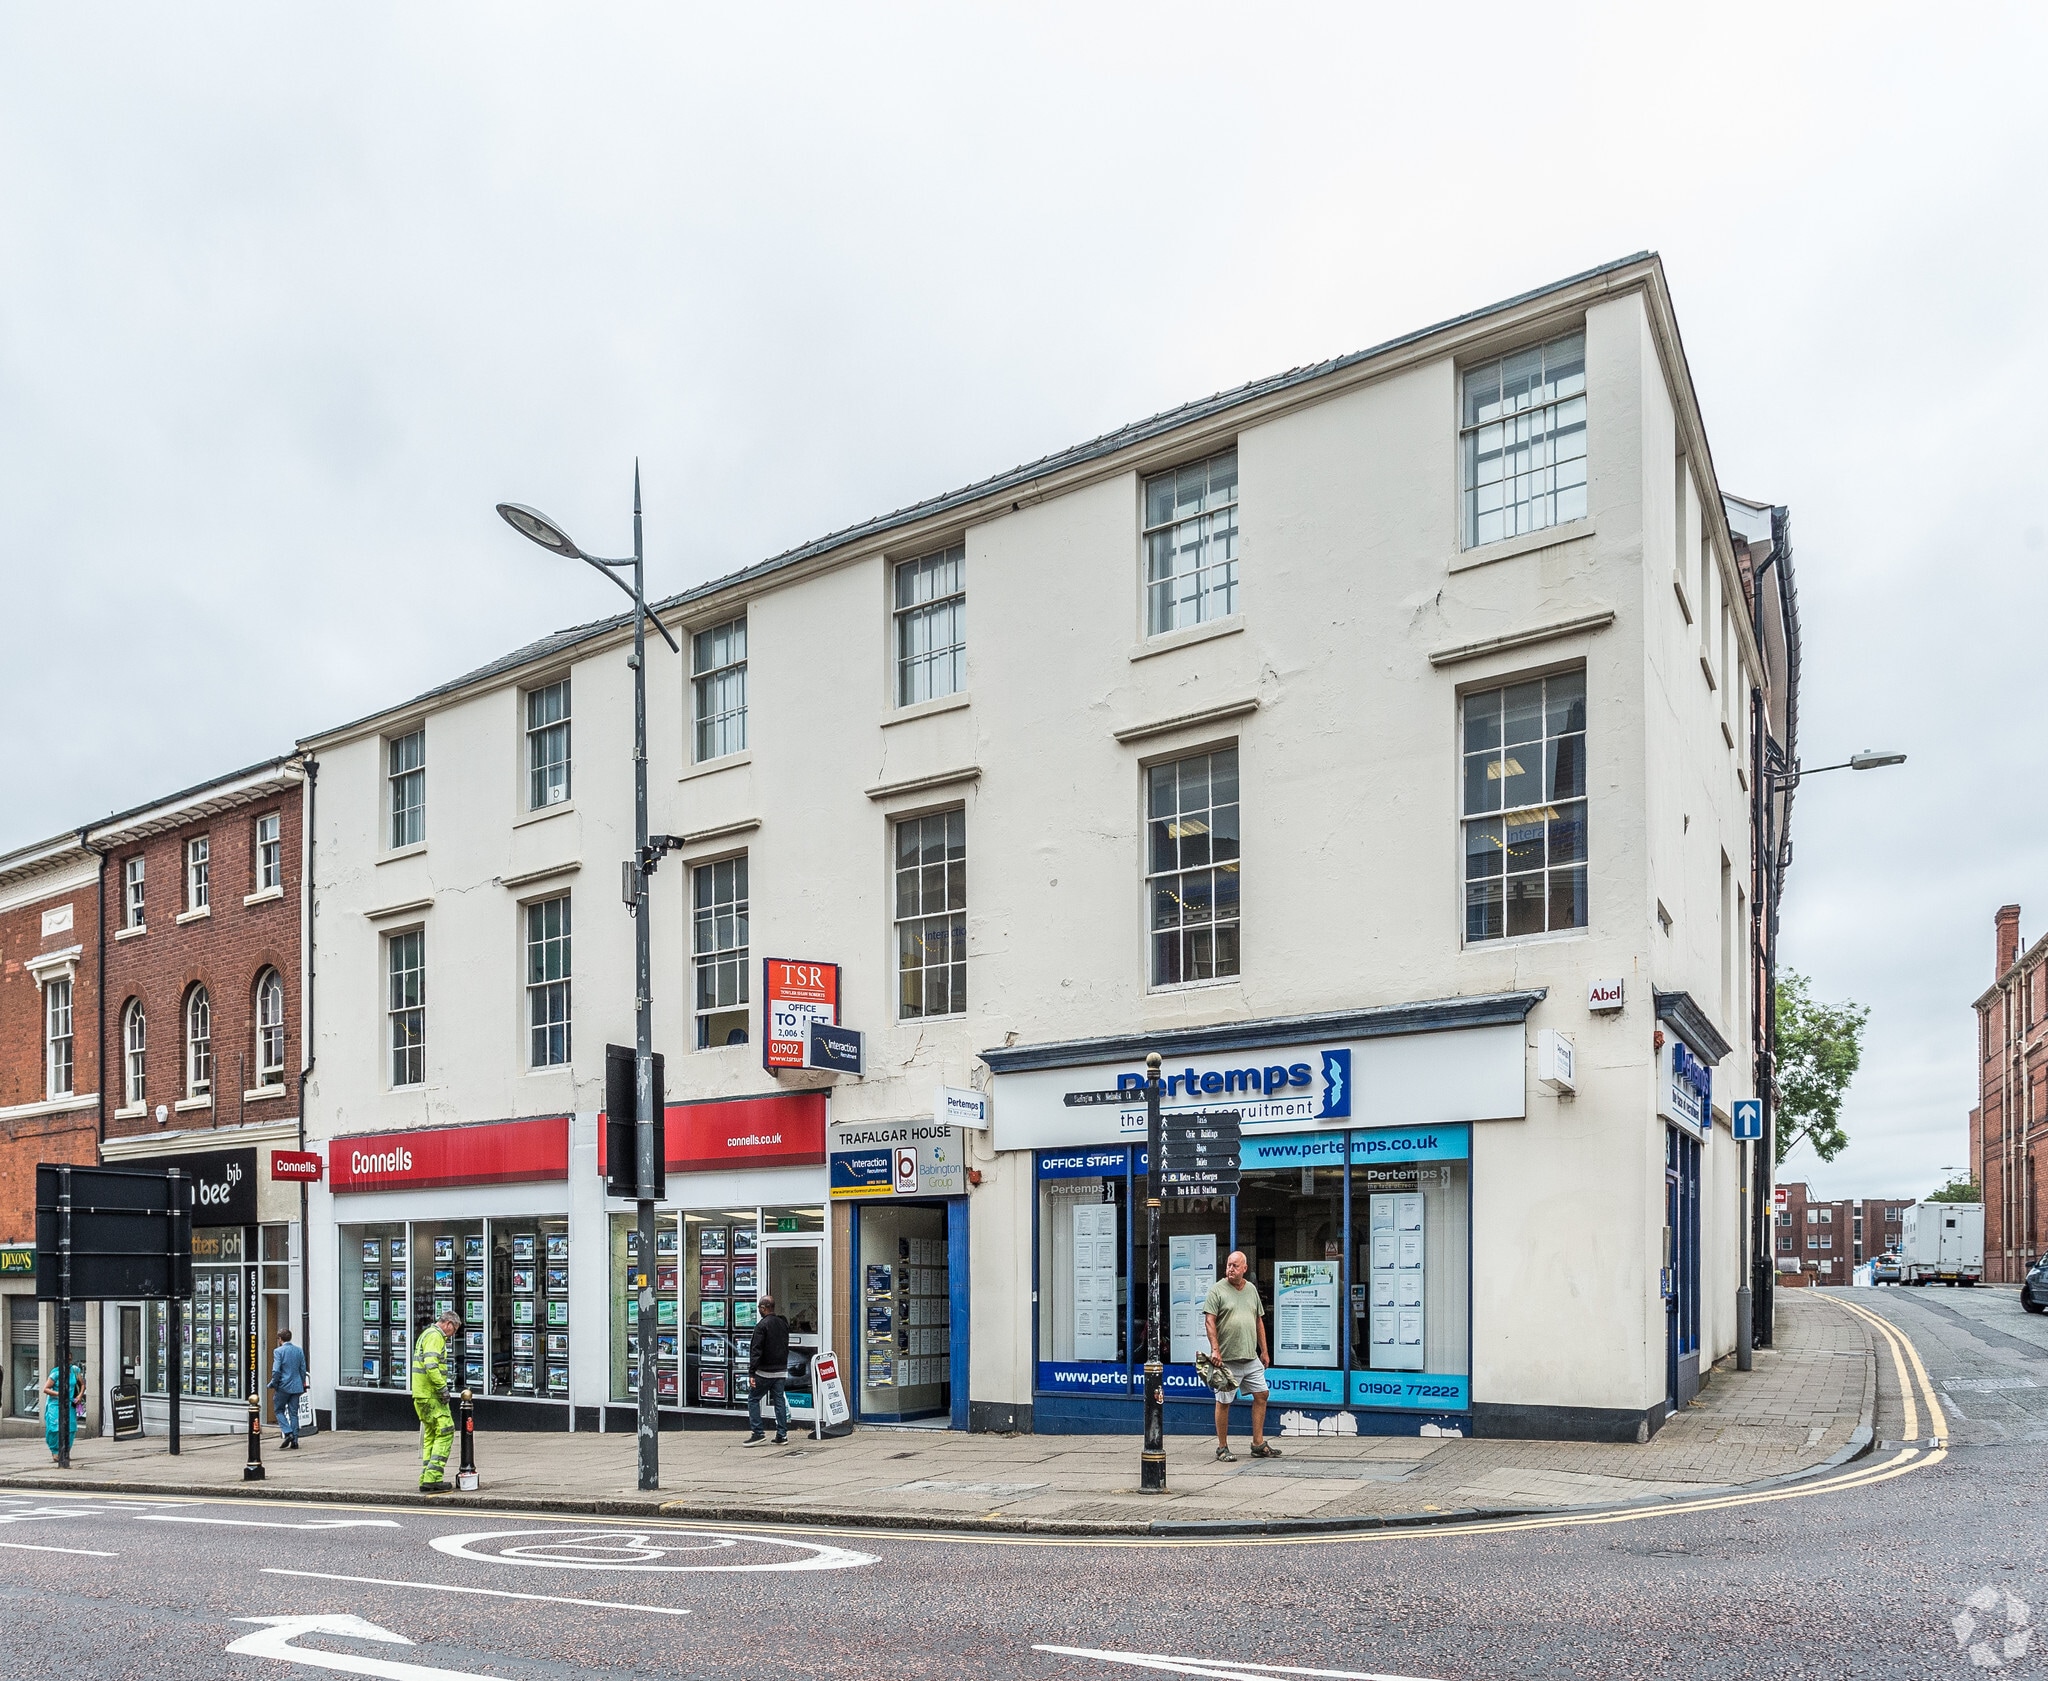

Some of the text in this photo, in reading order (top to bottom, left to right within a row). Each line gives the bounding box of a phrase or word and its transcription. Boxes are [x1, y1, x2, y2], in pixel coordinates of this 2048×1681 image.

[780, 964, 825, 988] TSR
[1590, 986, 1620, 1002] Abel
[788, 1003, 816, 1012] OFFICE
[775, 1013, 796, 1026] TO
[778, 1029, 798, 1038] 2,006
[771, 1043, 798, 1055] 01902
[829, 1040, 857, 1053] Interaction
[947, 1097, 979, 1110] Pertemps
[1120, 1114, 1144, 1127] the
[727, 1132, 782, 1147] connells.co.uk
[839, 1126, 951, 1145] TRAFALGAR HOUSE
[1258, 1135, 1438, 1158] www.pertemps.co.uk
[276, 1160, 316, 1173] Connells
[352, 1147, 412, 1175] Connells
[852, 1157, 888, 1168] Interaction
[1042, 1155, 1124, 1170] OFFICE STAFF
[226, 1163, 242, 1186] bjb
[920, 1164, 961, 1177] Babington
[1367, 1170, 1438, 1181] Pertemps
[928, 1176, 953, 1189] Group
[1051, 1184, 1105, 1194] Pertemps
[199, 1179, 230, 1205] bee
[1, 1251, 32, 1269] DIXONS
[249, 1270, 257, 1394] www.buttersjohnbee.com
[1054, 1371, 1206, 1387] www.pertem.co.uk
[1266, 1379, 1332, 1393] DUSTRIAL
[1359, 1383, 1460, 1398] 01902 772222
